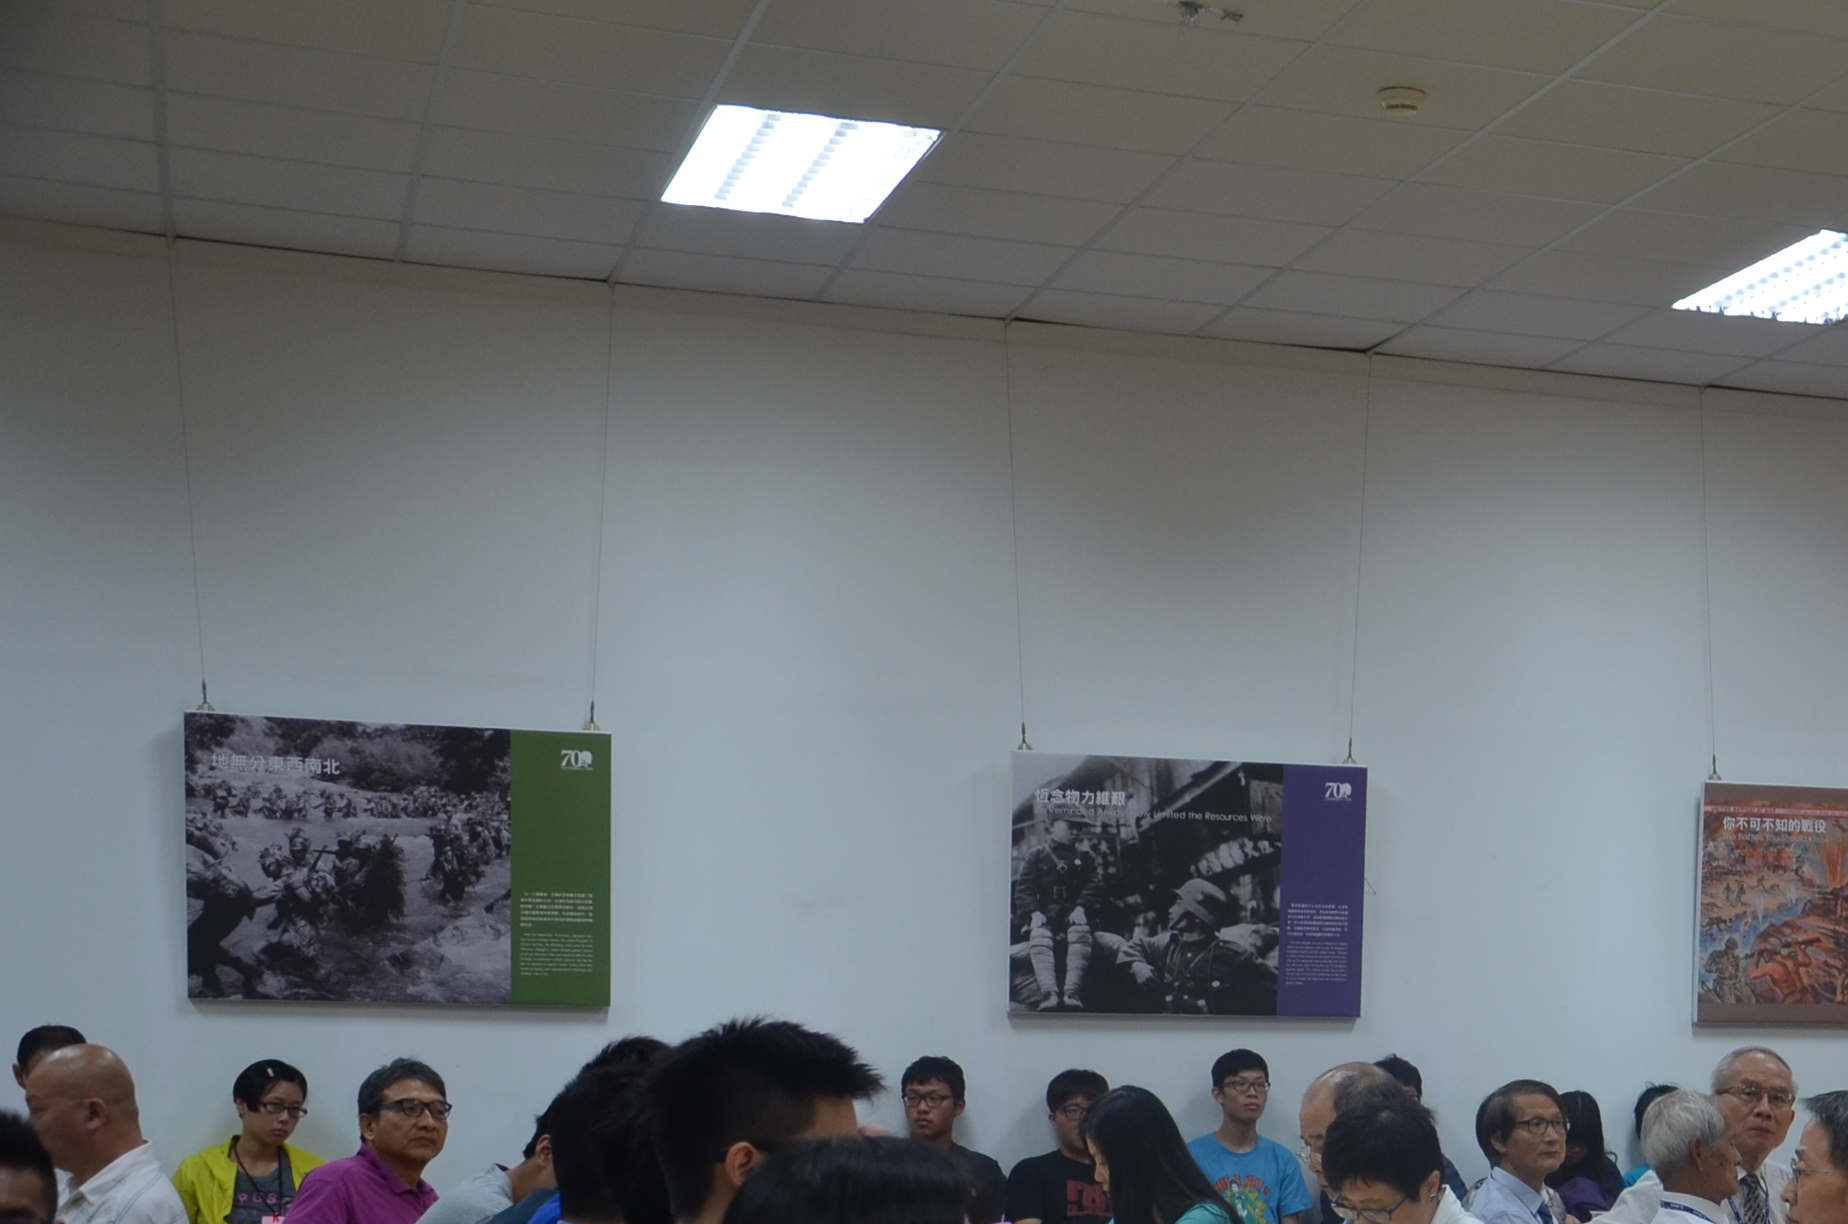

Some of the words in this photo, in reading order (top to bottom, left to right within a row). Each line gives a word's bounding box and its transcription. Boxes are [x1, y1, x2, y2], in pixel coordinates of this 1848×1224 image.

[211, 752, 341, 775] 地無分東西南北
[1153, 810, 1186, 820] Limited
[1188, 812, 1203, 820] the
[1205, 812, 1248, 822] Resources
[1250, 814, 1272, 823] Were
[1723, 817, 1827, 834] 你不可不知的戰役
